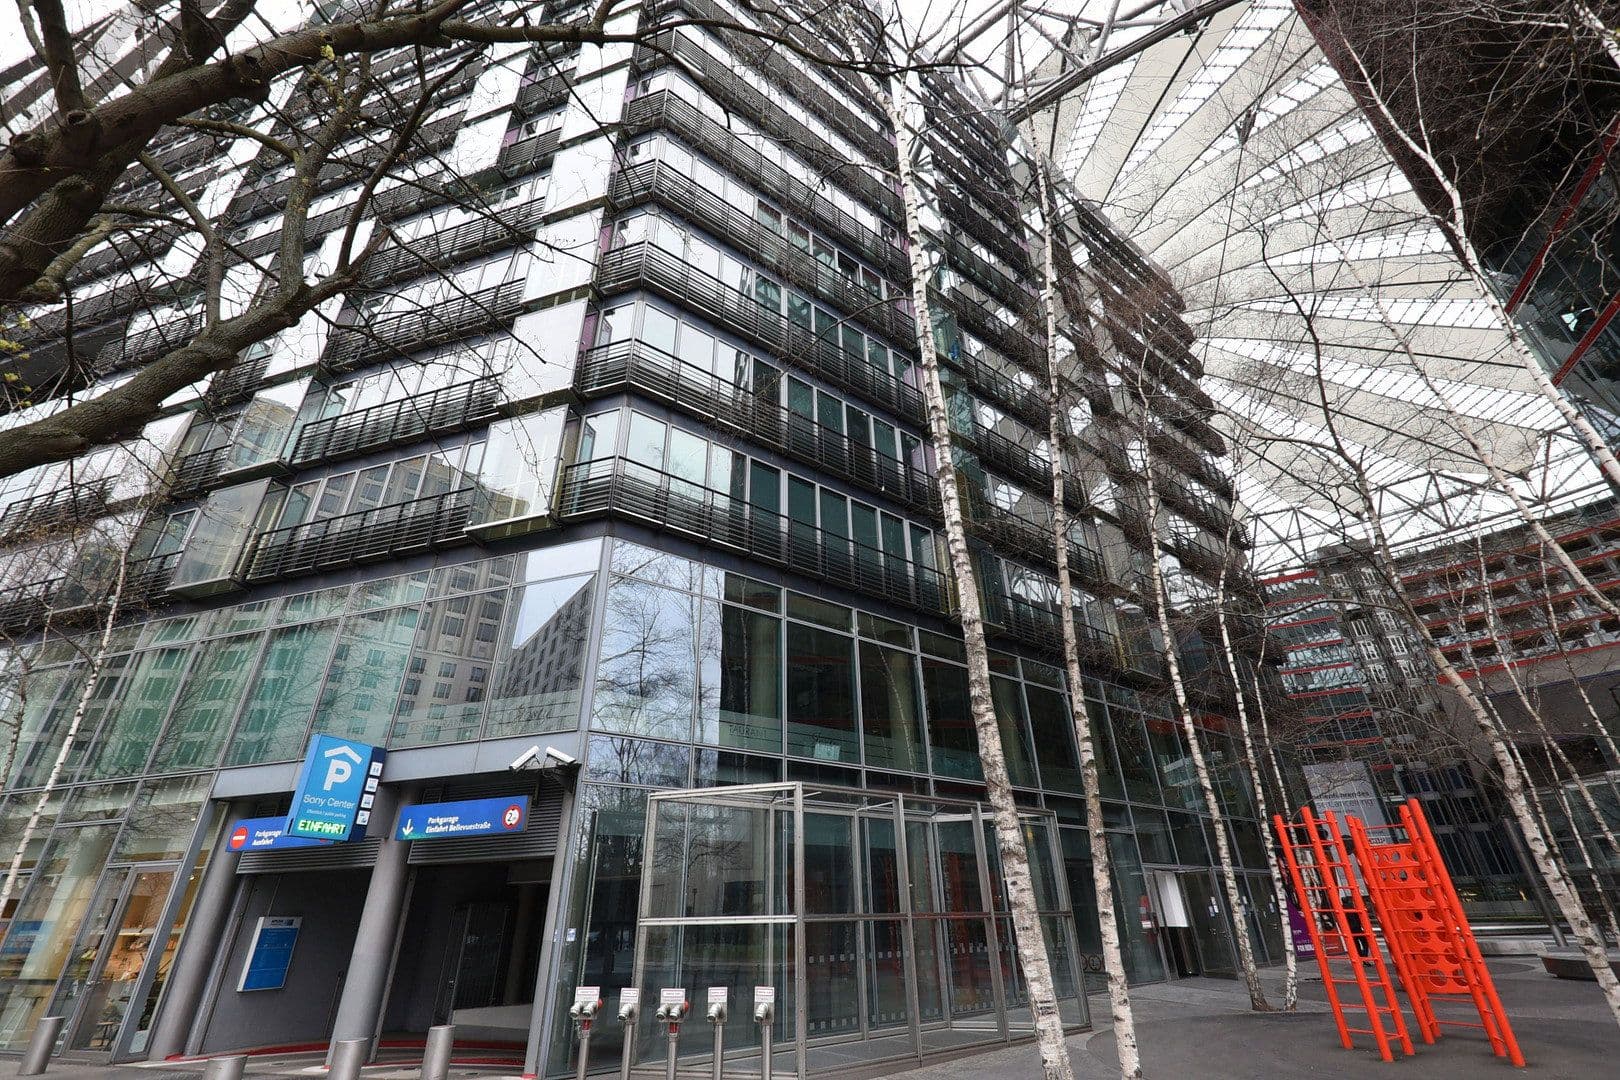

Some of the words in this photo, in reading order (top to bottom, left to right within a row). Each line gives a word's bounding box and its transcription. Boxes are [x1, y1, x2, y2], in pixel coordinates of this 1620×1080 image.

[324, 759, 351, 790] P
[303, 794, 326, 807] Sony
[327, 797, 355, 809] Center
[298, 819, 346, 834] EINFAHRT
[427, 815, 459, 825] Parkgarage
[254, 830, 282, 838] Parkgarage
[425, 824, 449, 834] Einfahrt
[449, 821, 491, 832] Bellevuestraße
[252, 838, 274, 846] Ausfahrt
